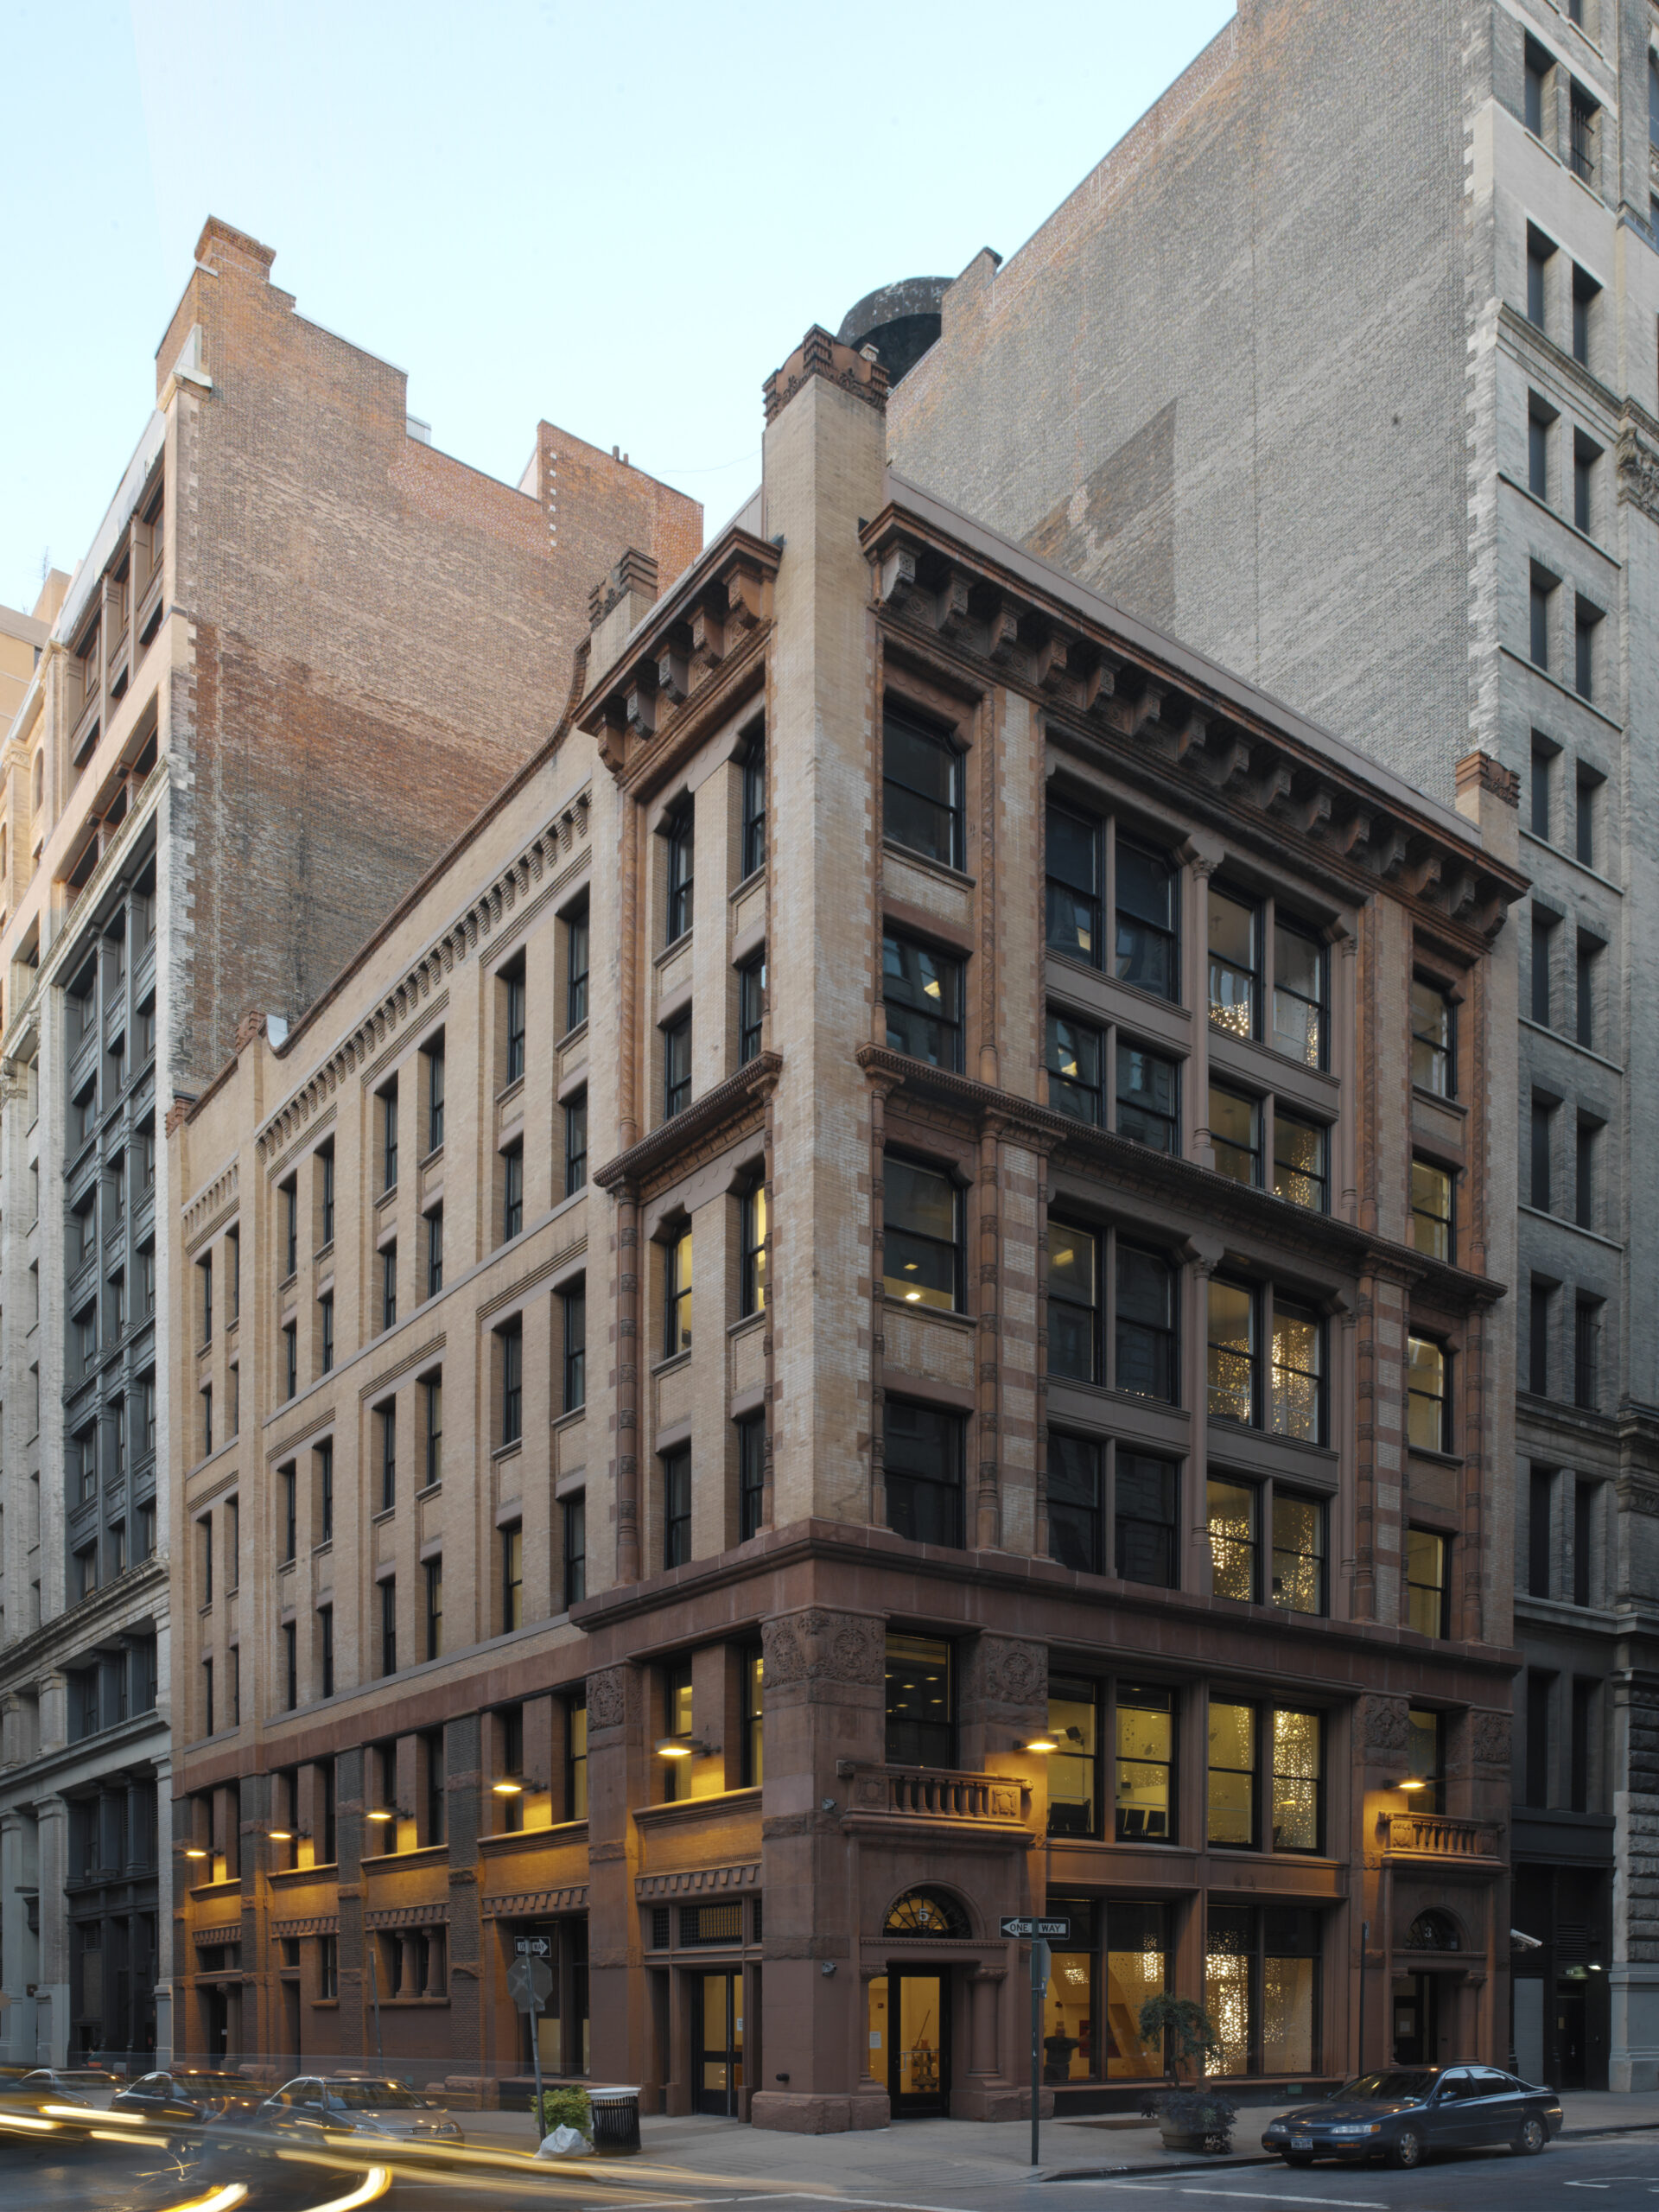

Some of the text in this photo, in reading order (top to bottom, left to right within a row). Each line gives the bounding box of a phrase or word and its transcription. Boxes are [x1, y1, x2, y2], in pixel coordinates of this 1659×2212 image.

[918, 1908, 929, 1921] 5
[1009, 1923, 1029, 1932] ONE
[1425, 1927, 1432, 1938] 3
